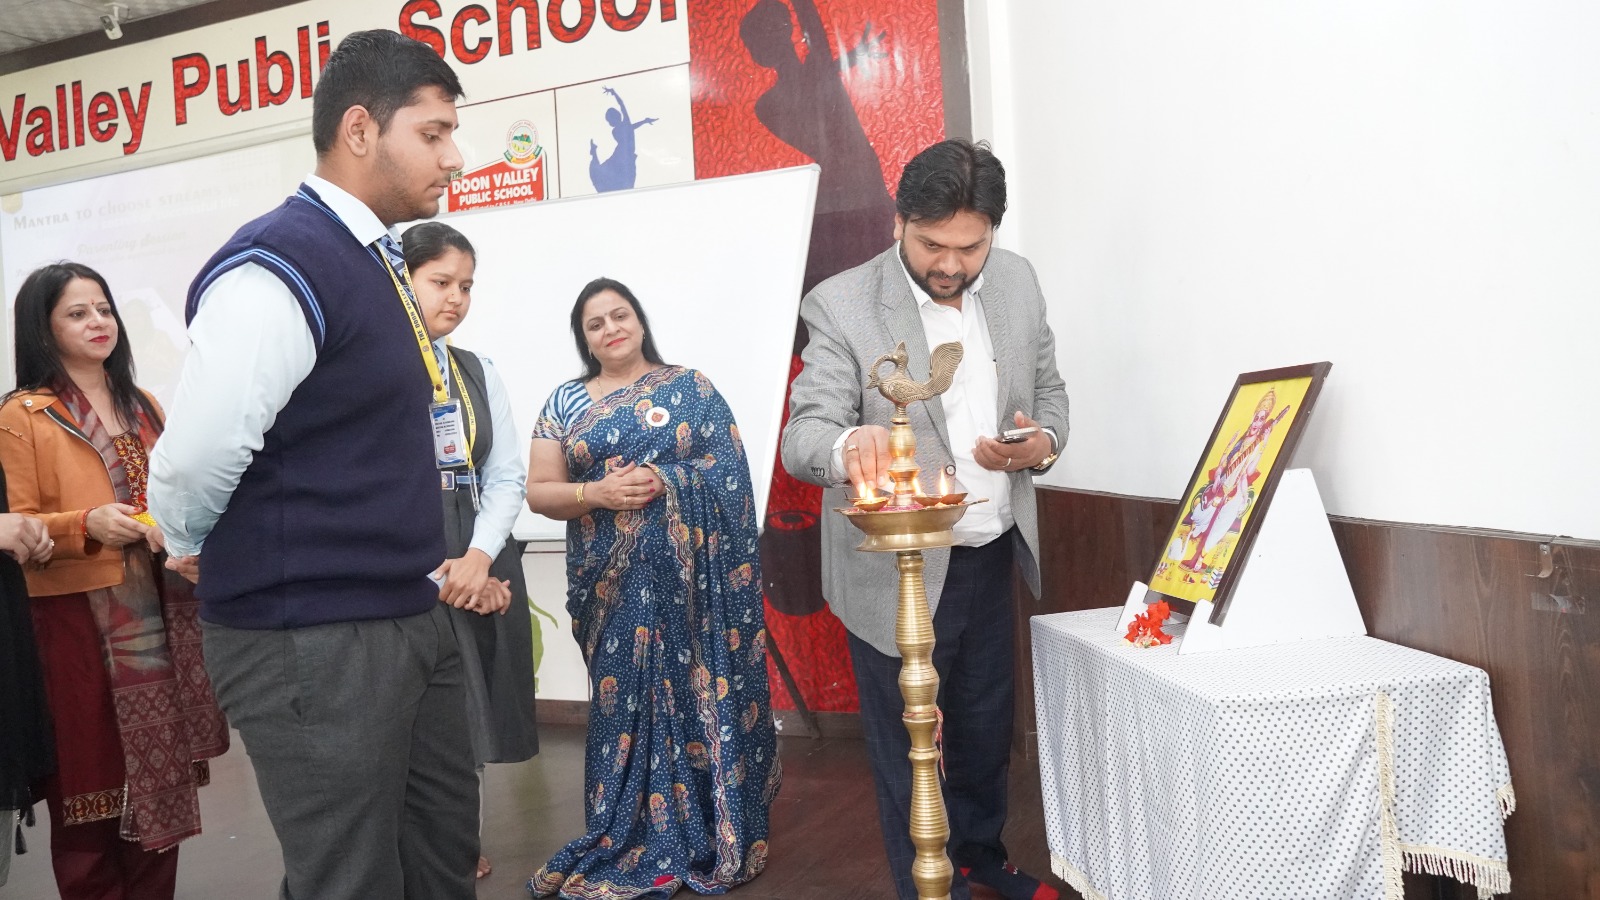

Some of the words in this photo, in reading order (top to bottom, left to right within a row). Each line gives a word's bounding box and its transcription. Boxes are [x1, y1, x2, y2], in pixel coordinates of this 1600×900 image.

[0, 80, 153, 163] Valley
[172, 20, 332, 127] Publi
[452, 175, 491, 195] DOON
[492, 167, 539, 188] VALLEY
[459, 190, 492, 206] PUBLIC
[493, 185, 534, 201] SCHOOL
